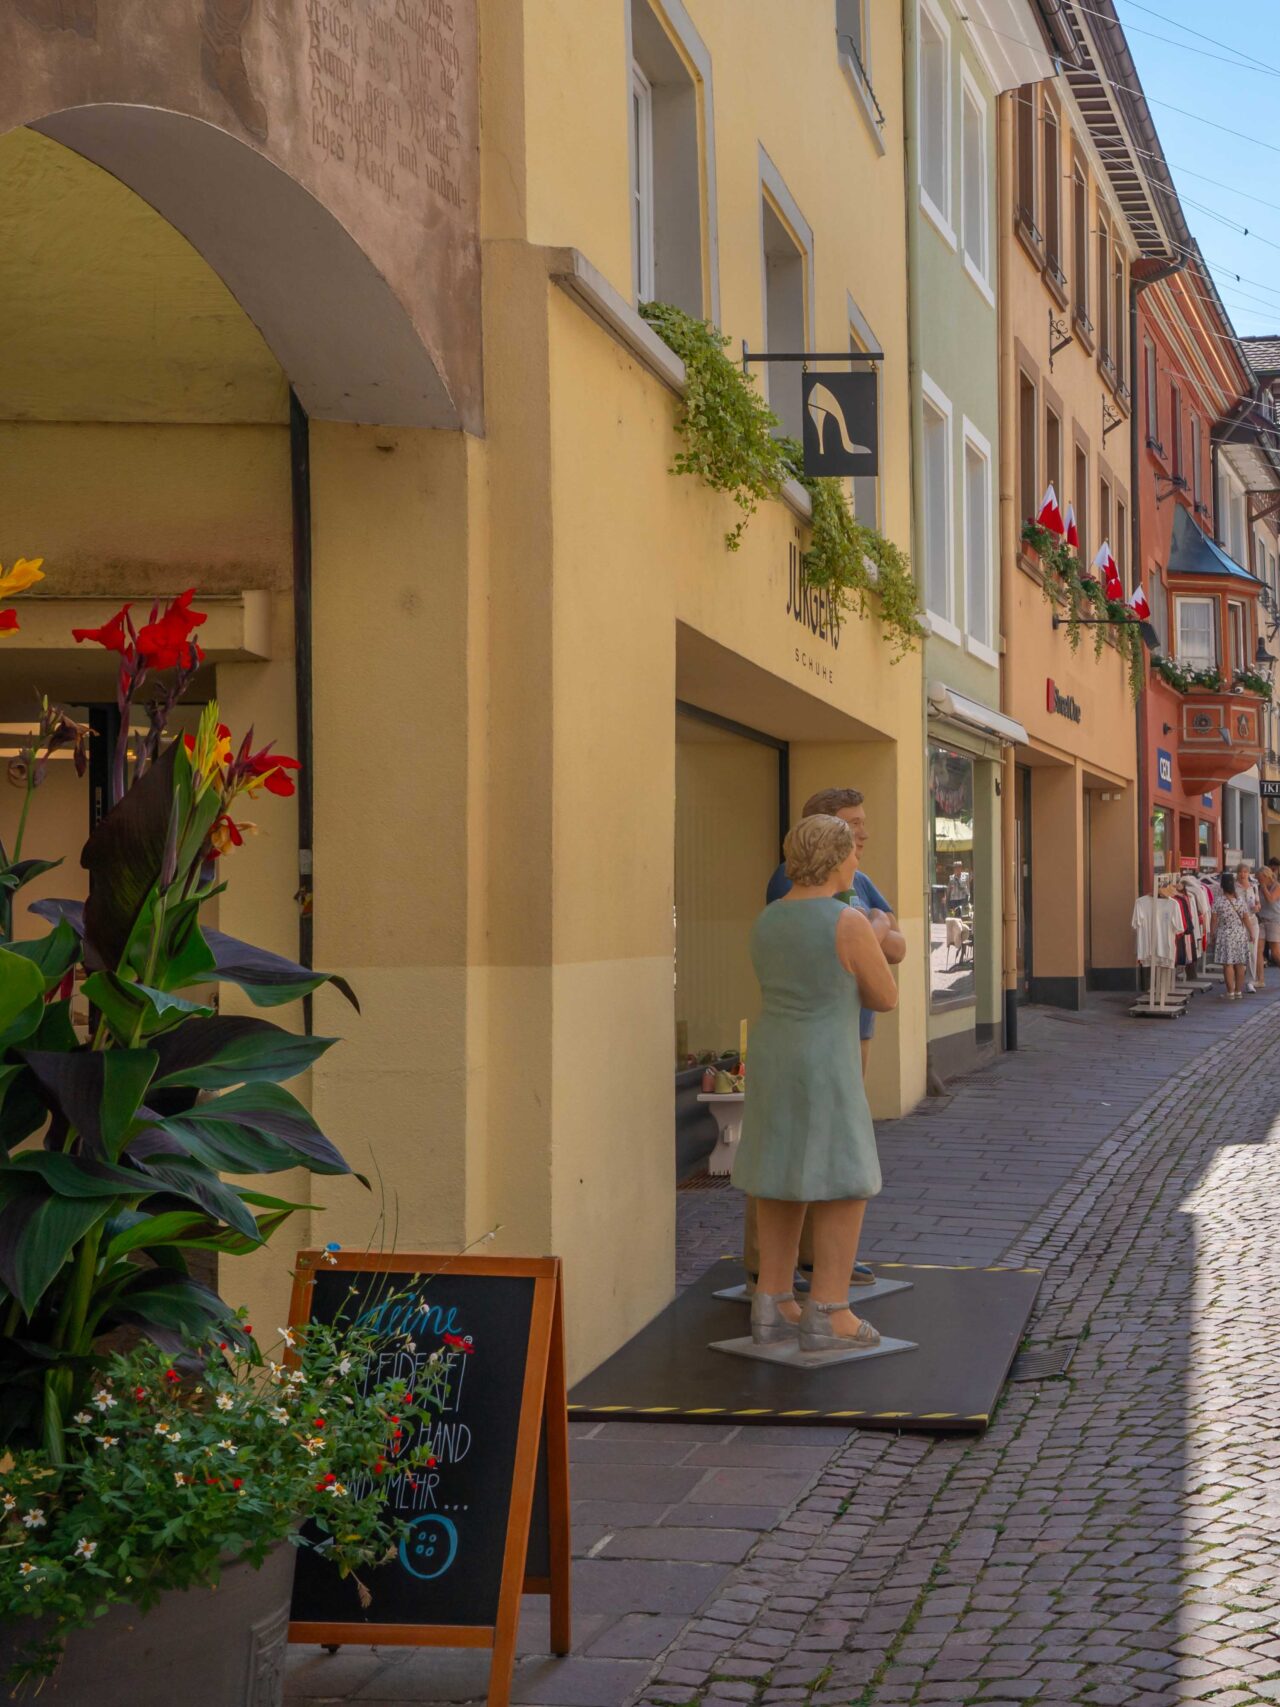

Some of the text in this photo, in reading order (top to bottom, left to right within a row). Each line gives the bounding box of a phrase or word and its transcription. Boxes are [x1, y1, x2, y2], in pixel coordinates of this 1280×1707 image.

[794, 648, 834, 684] SCHUHE
[418, 1421, 471, 1463] HAND
[384, 1472, 440, 1509] MEHR
